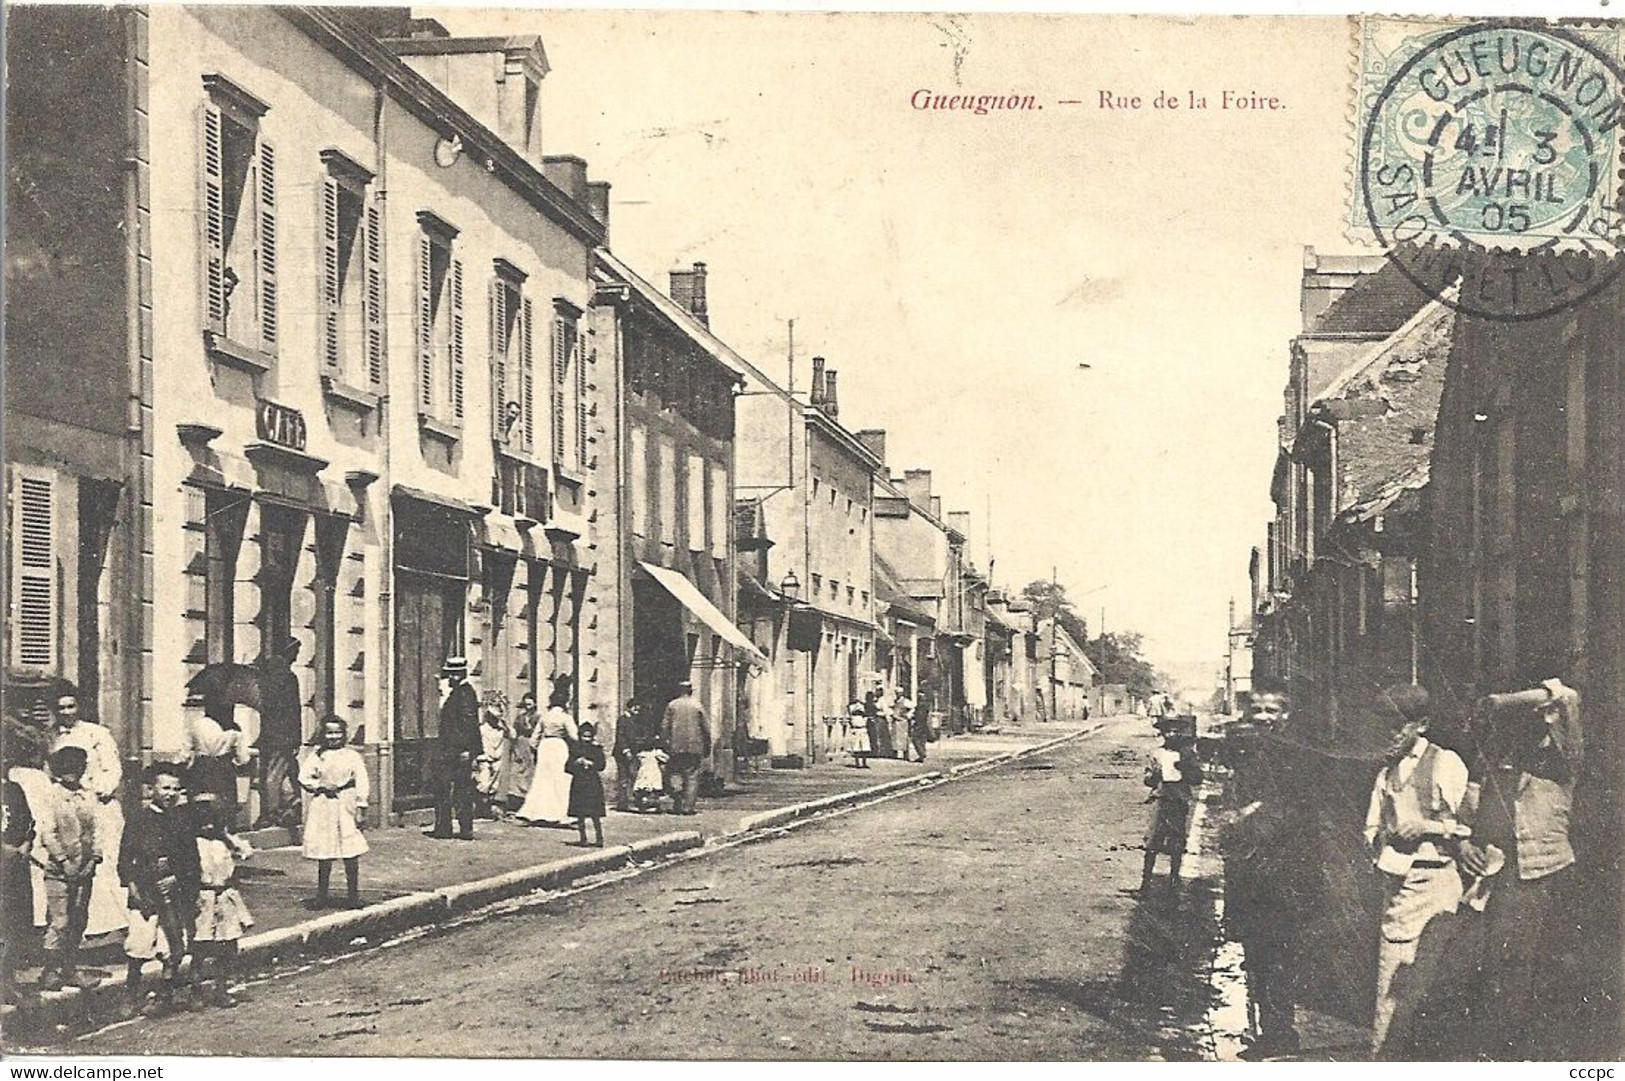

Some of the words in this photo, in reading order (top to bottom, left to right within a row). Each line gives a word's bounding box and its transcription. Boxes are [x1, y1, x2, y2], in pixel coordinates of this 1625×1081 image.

[1419, 35, 1625, 134] GUEUGNON
[1456, 166, 1565, 204] AVRIL
[1482, 202, 1531, 233] 05
